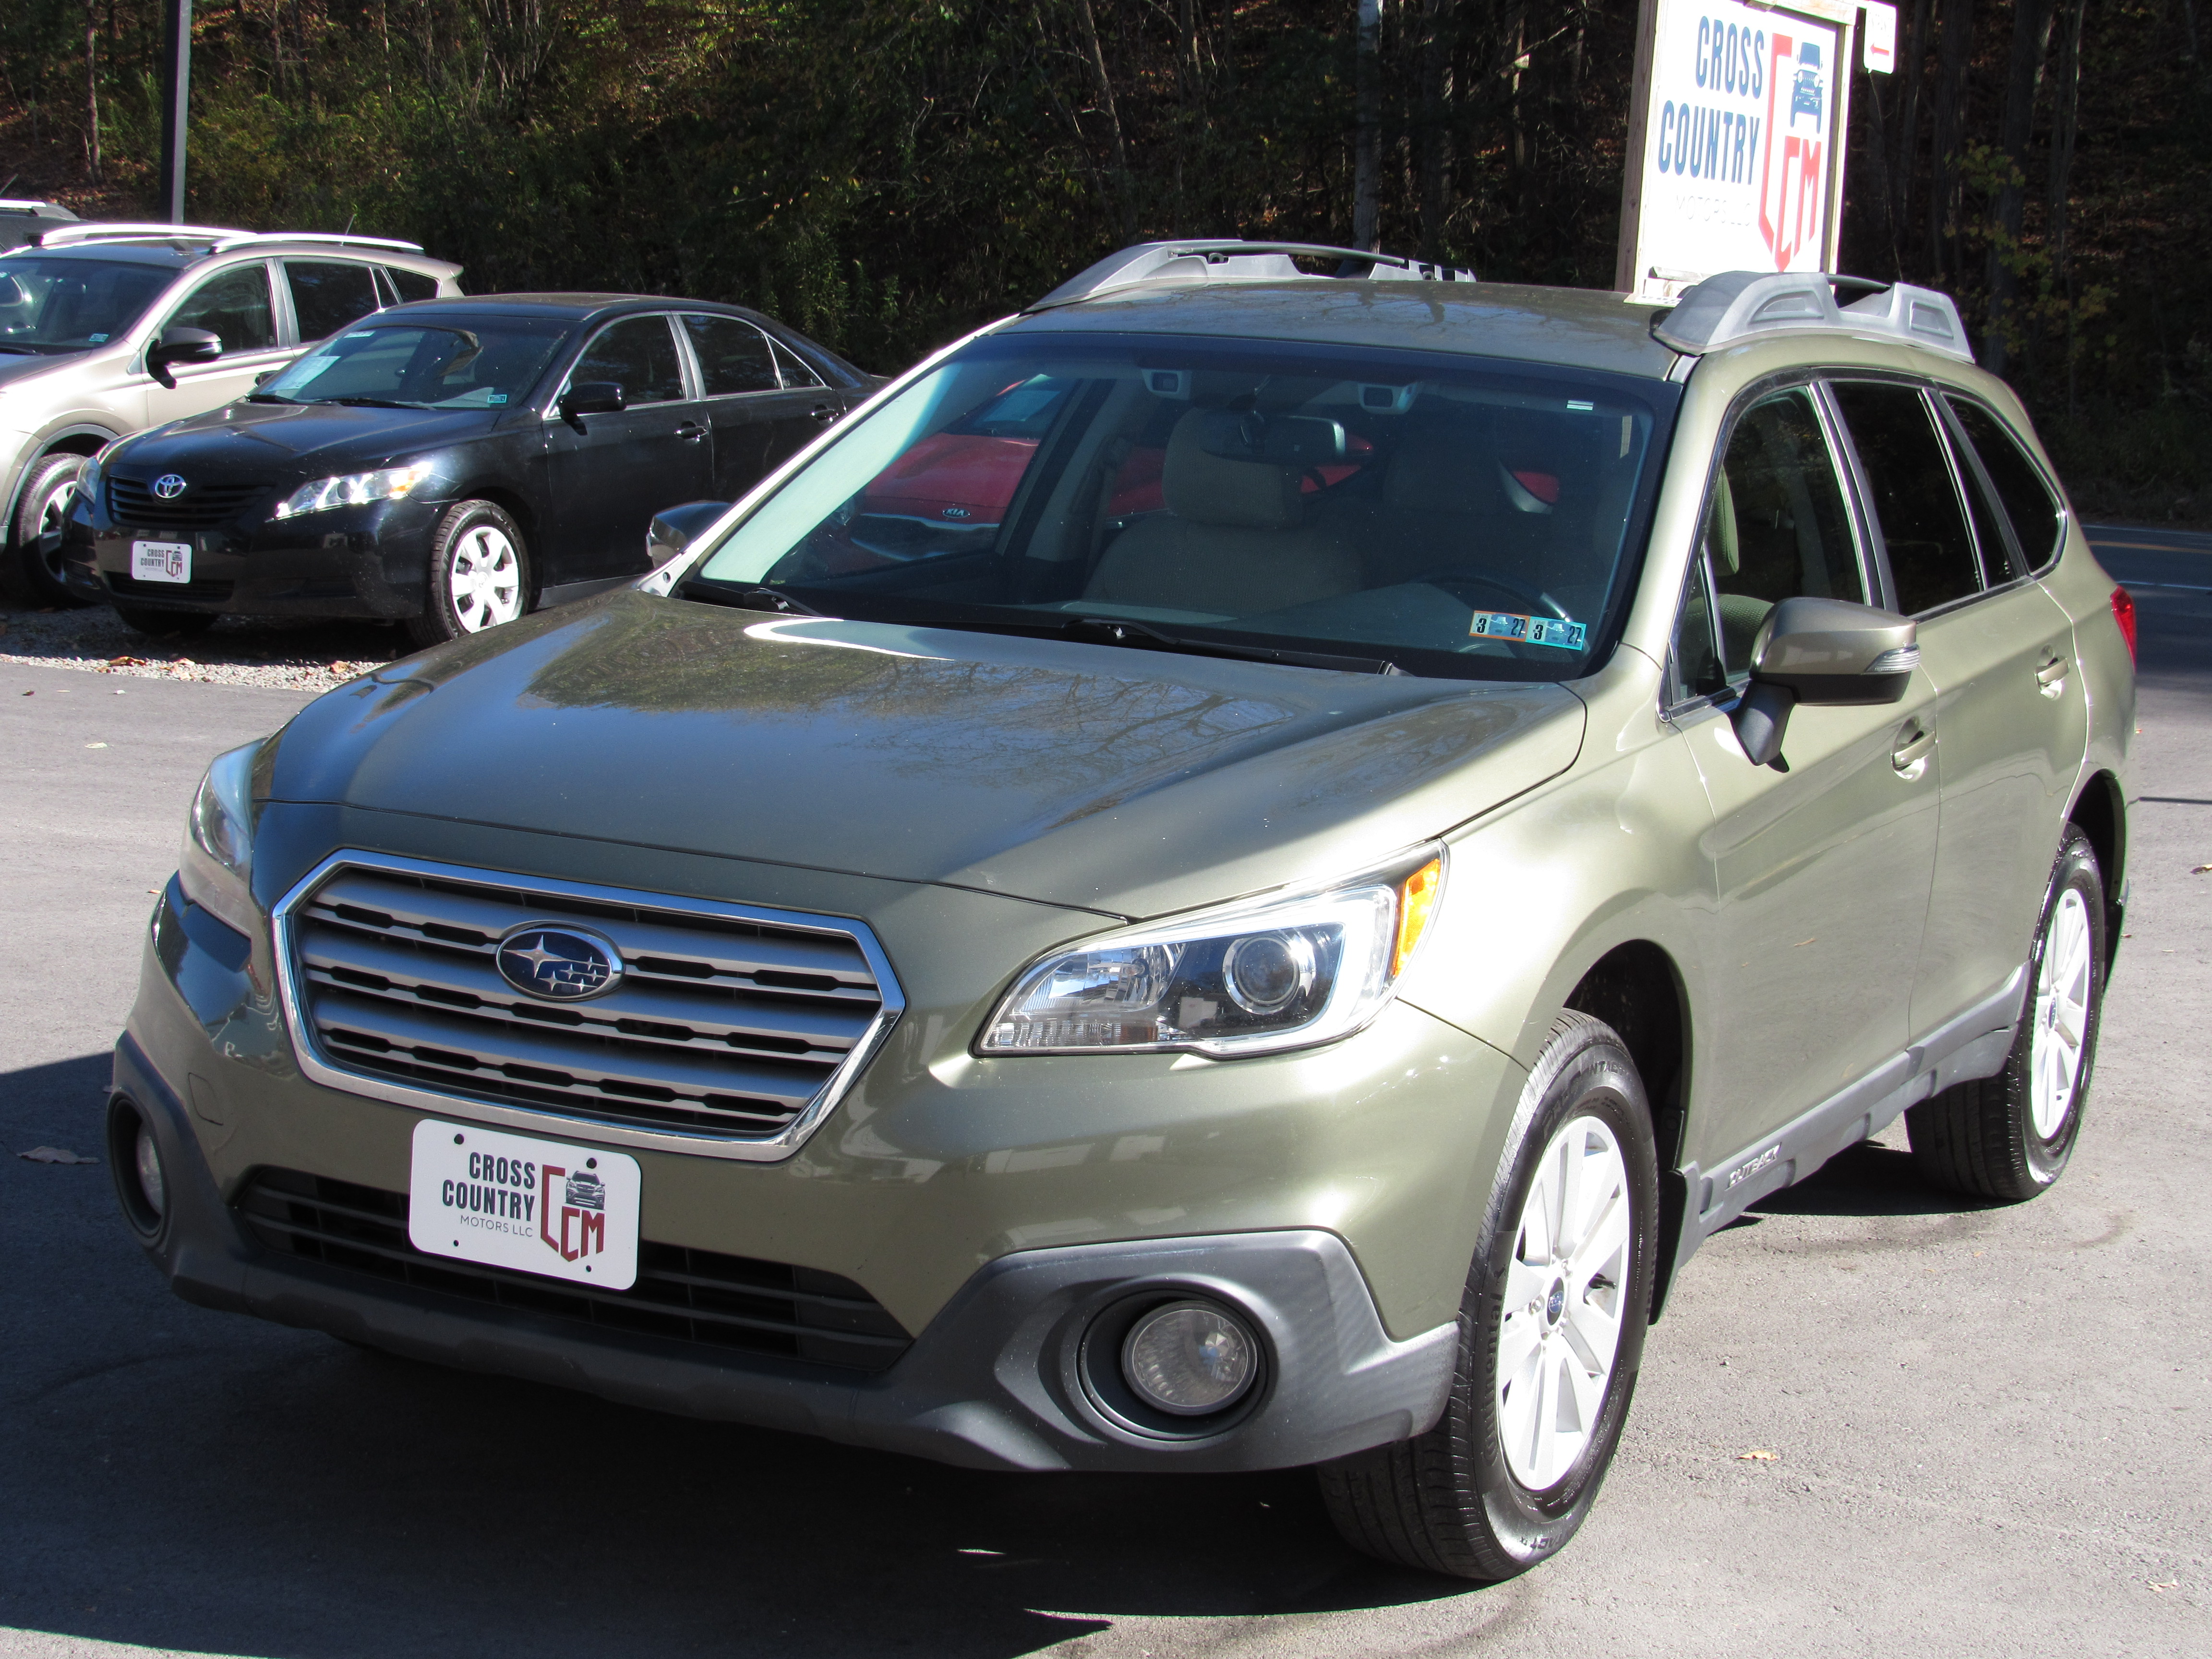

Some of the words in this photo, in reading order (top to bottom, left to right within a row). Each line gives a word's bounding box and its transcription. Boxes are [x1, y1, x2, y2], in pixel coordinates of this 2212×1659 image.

[1696, 16, 1764, 99] CROSS
[1658, 100, 1760, 185] COUNTRY
[141, 558, 164, 567] COUNTRY
[147, 549, 165, 557] CROSS
[1477, 618, 1487, 633] 3
[1511, 618, 1525, 637] 27
[1535, 625, 1543, 640] 3
[1568, 626, 1581, 645] 27
[469, 1152, 536, 1190] CROSS
[442, 1179, 535, 1222] COUNTRY
[460, 1215, 509, 1233] MOTORS
[513, 1224, 533, 1238] LLC
